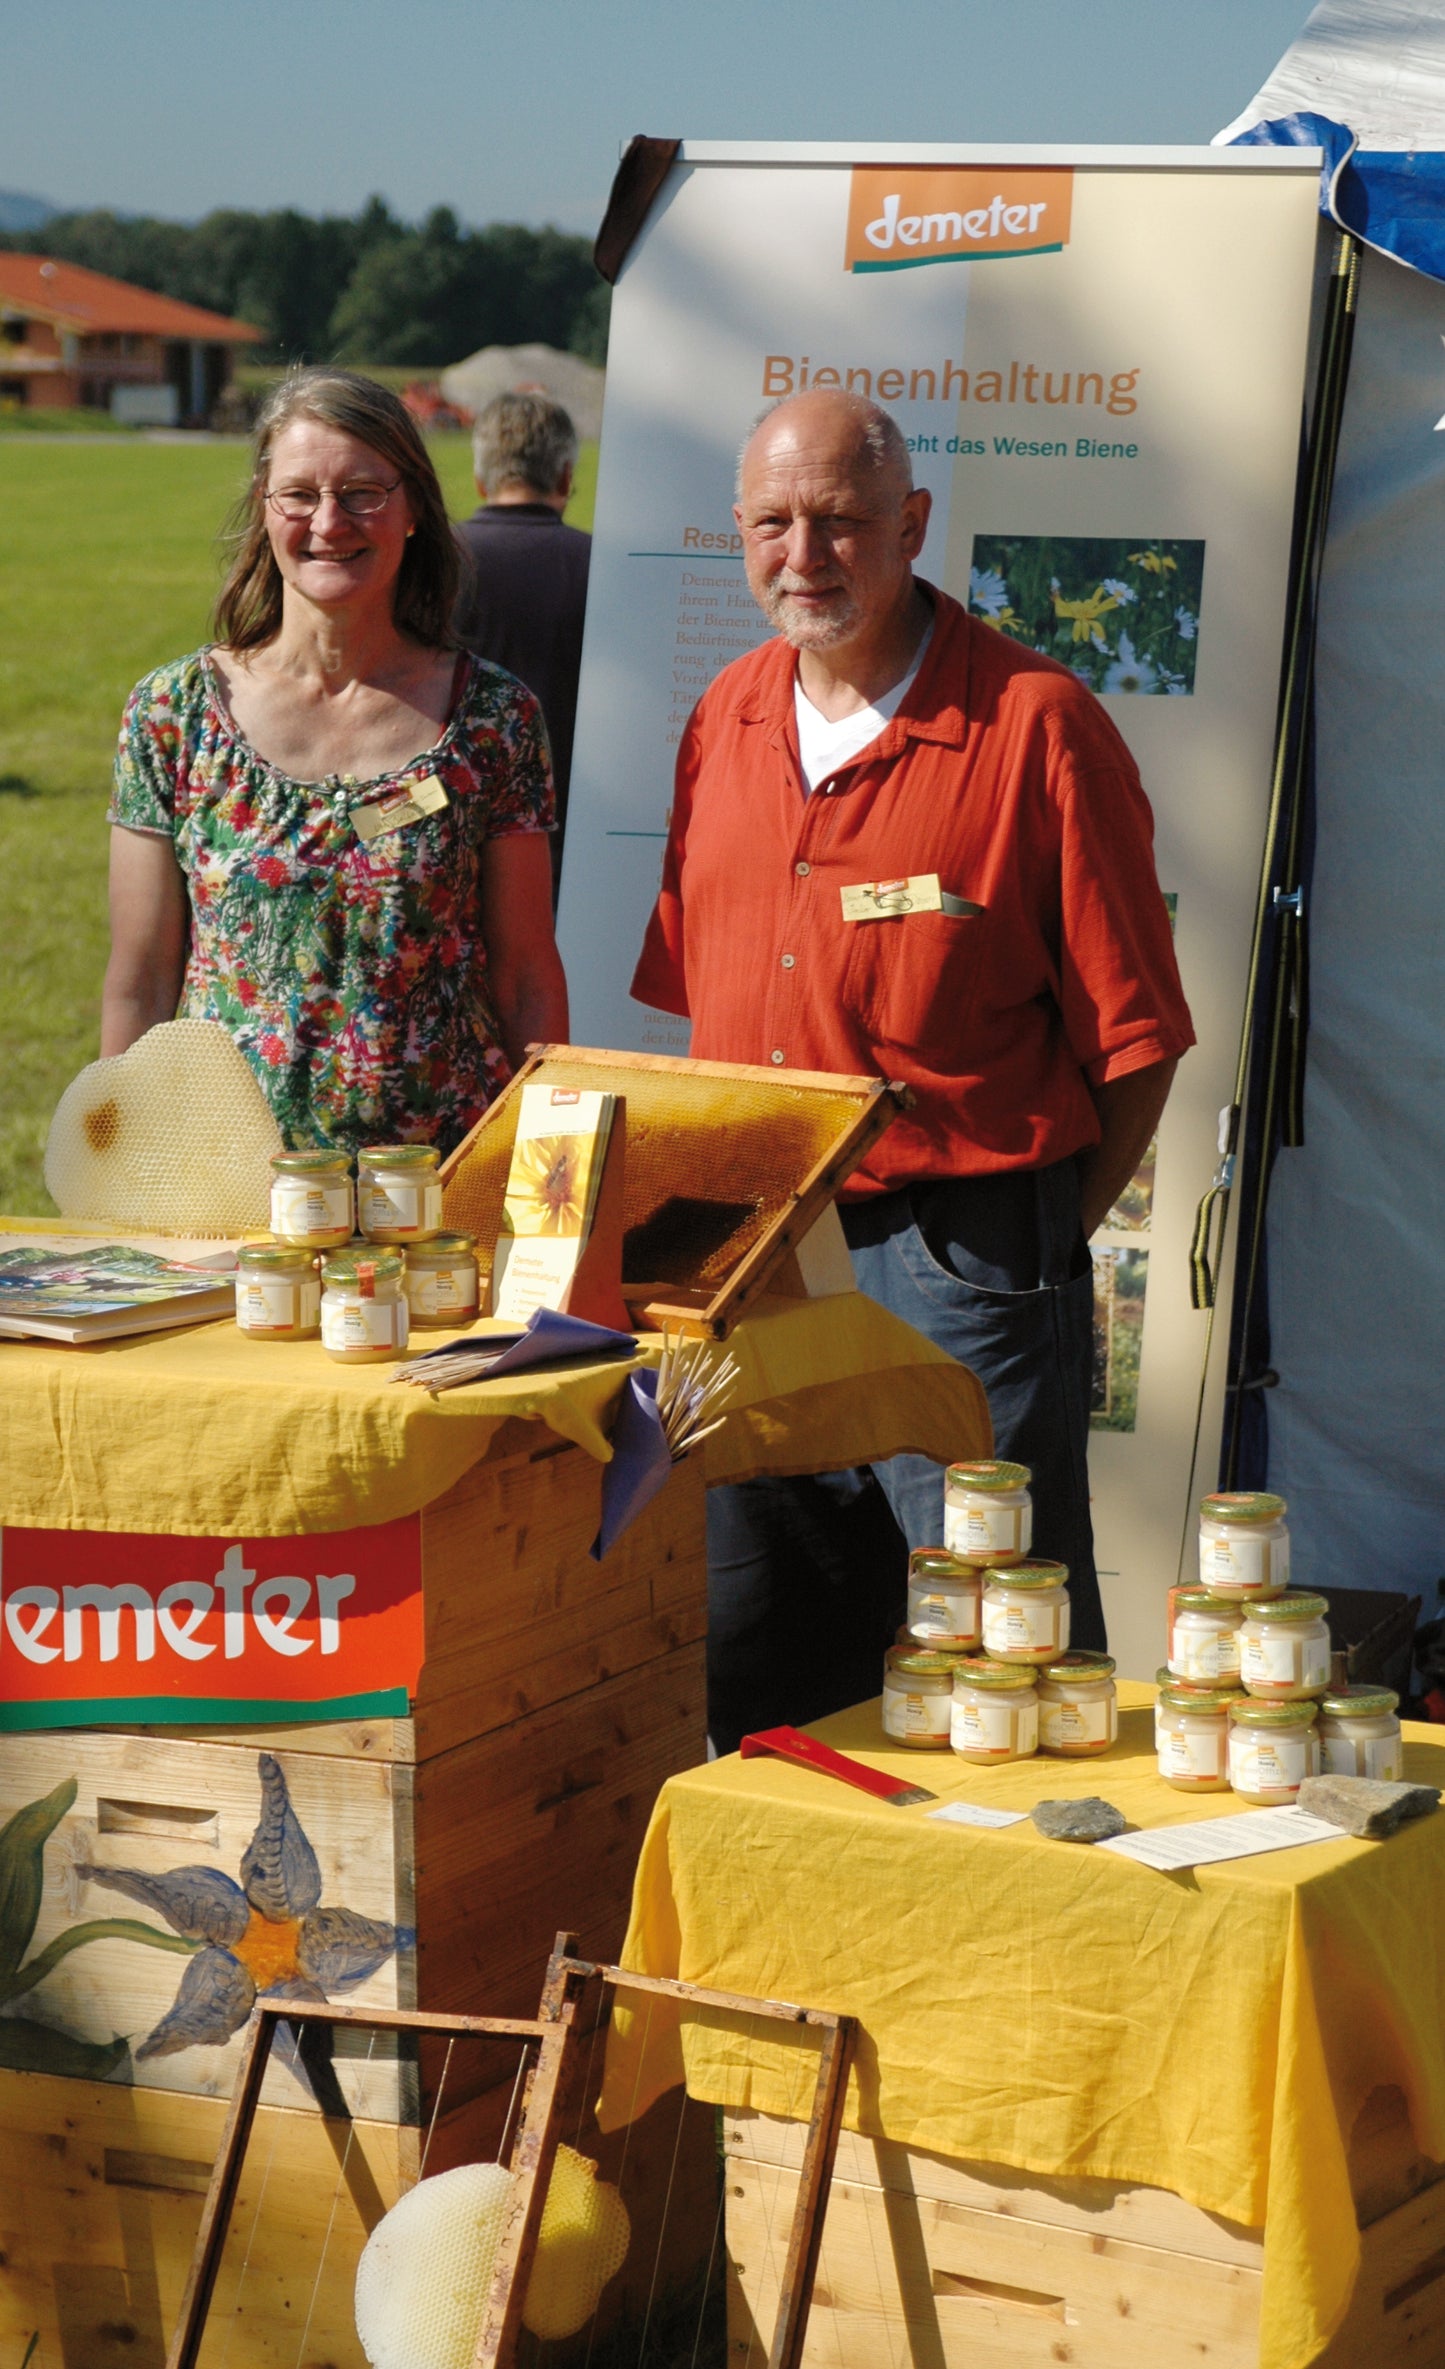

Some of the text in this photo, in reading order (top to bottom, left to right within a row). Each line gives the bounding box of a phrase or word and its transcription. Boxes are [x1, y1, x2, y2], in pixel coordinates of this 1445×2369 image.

[865, 194, 1047, 249] demeter
[761, 355, 1141, 416] Bienenhaltung
[905, 434, 1139, 458] eht das Wesen Biene
[683, 527, 744, 554] Resp
[679, 592, 761, 609] ihrem Han
[677, 612, 699, 626] der
[704, 613, 749, 628] Bienen
[1, 1544, 357, 1665] emeter
